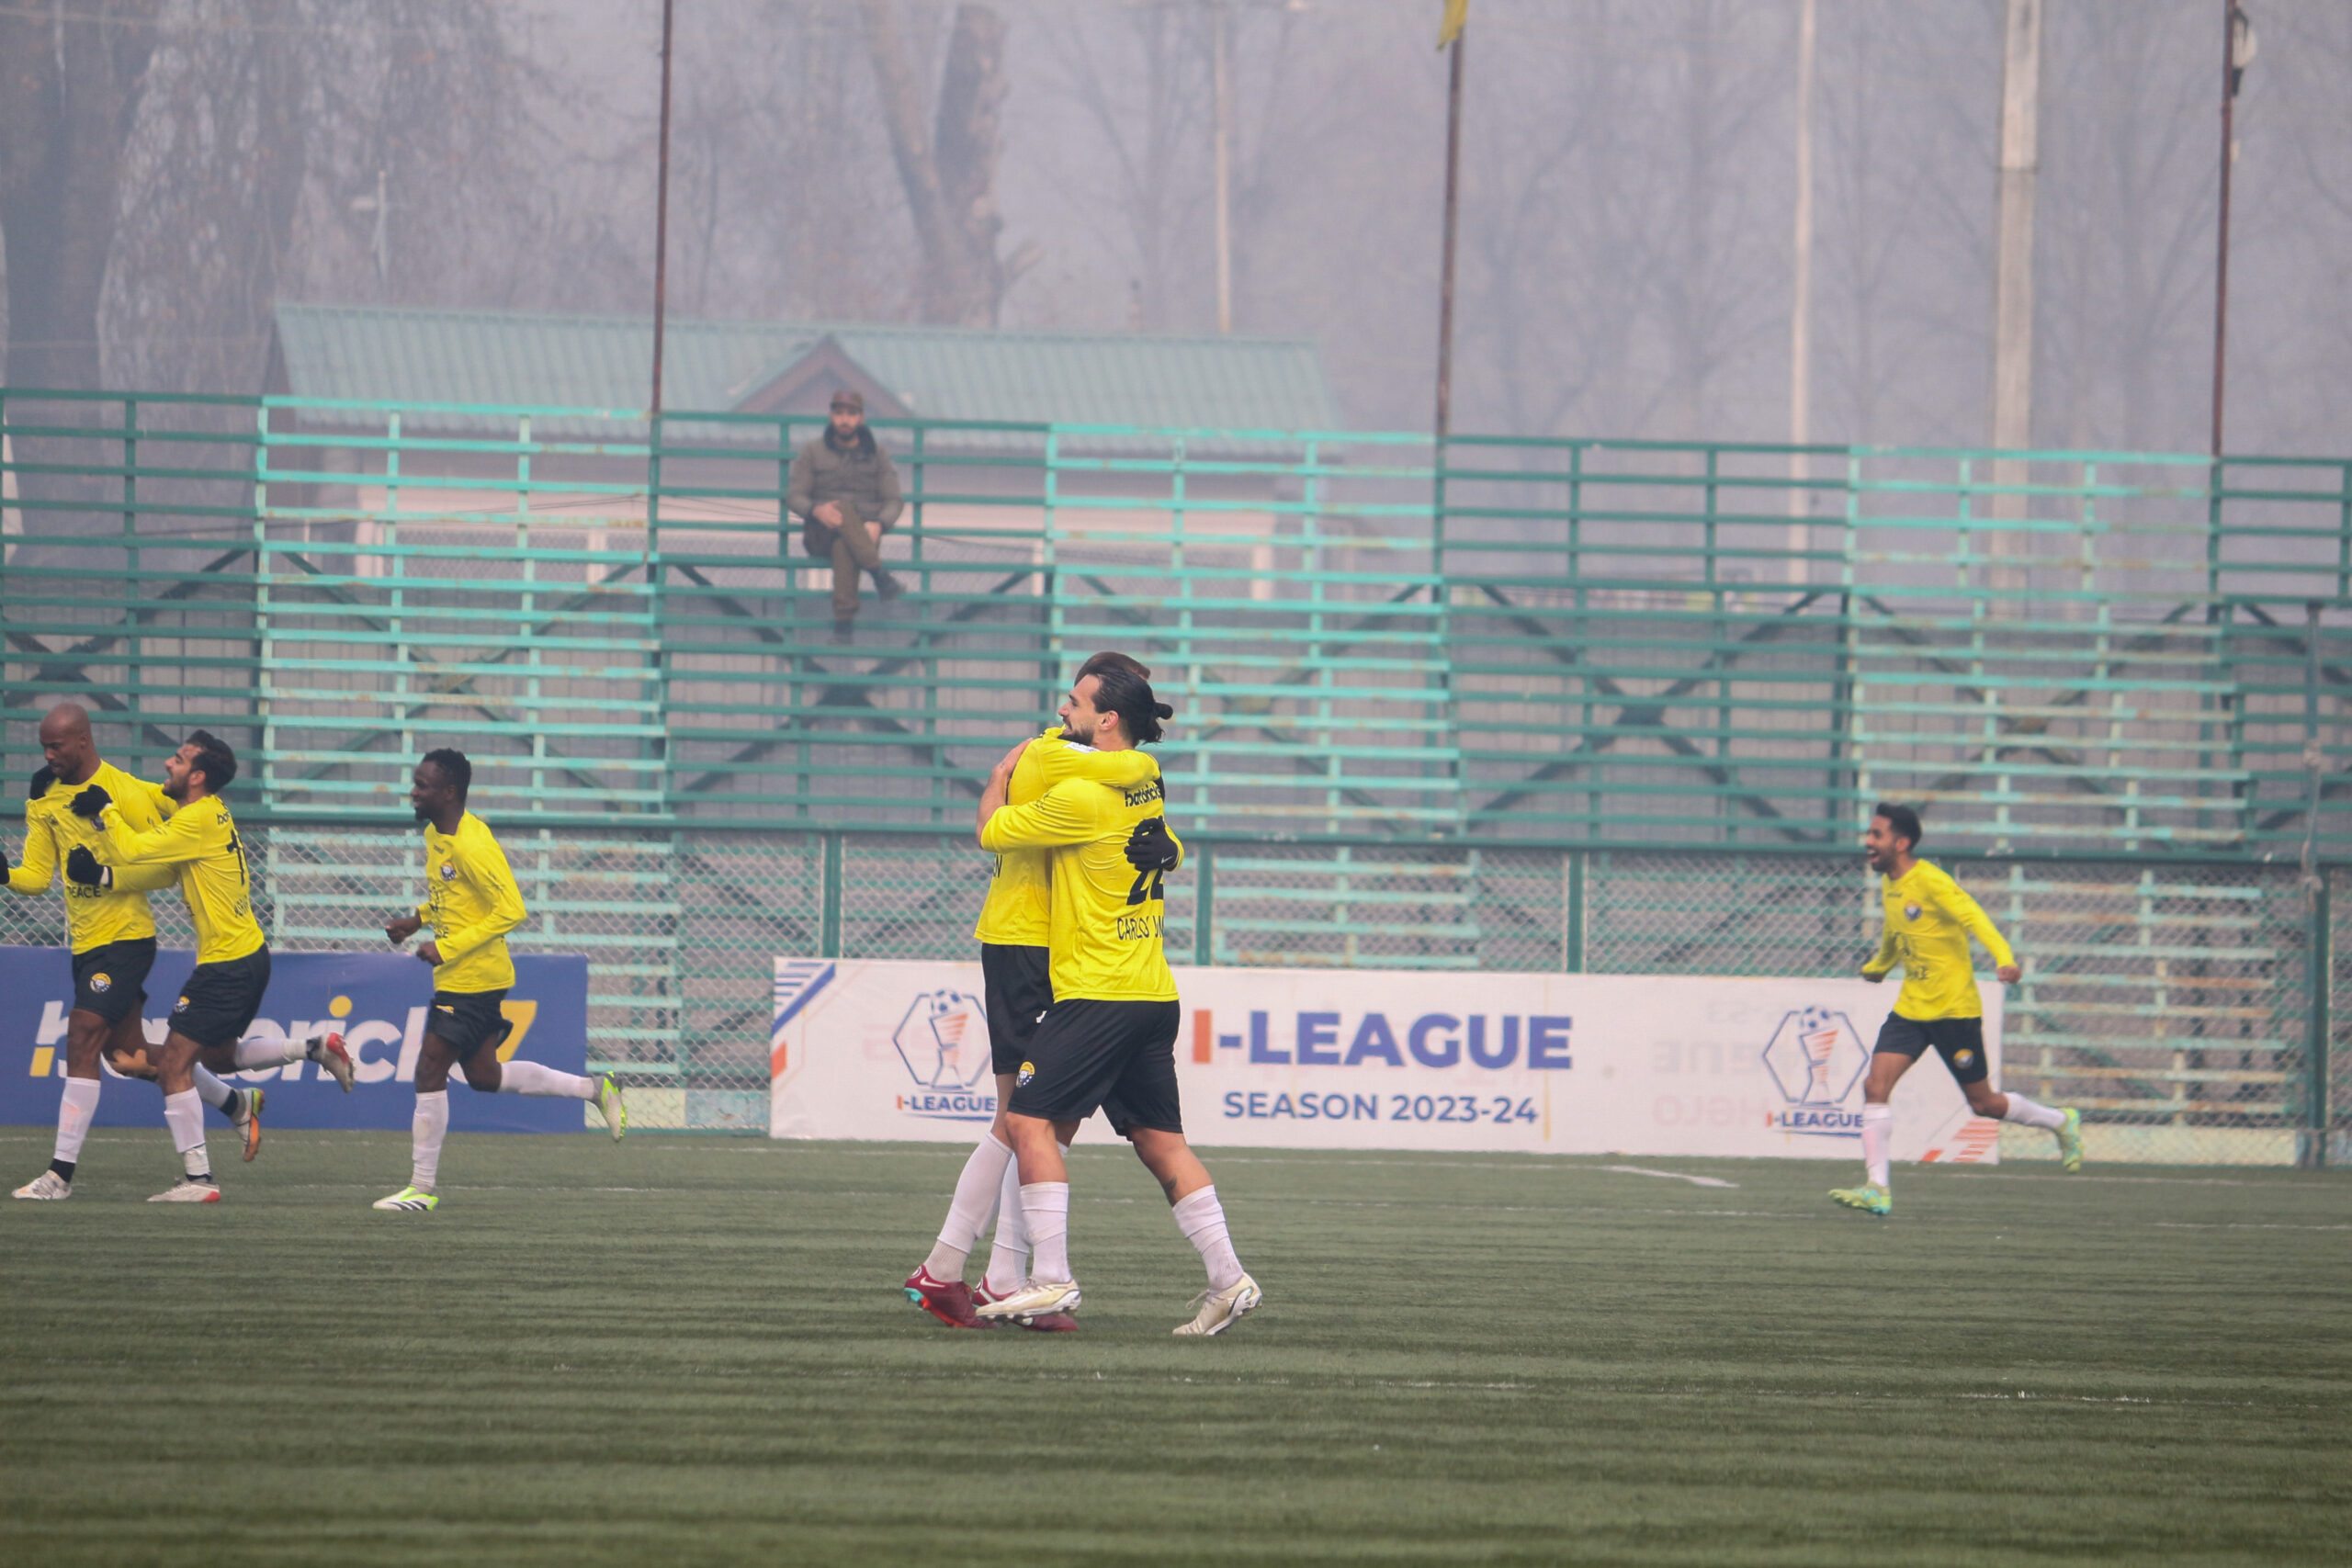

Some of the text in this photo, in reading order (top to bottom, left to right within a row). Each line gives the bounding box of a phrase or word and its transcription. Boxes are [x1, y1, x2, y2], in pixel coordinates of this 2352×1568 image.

[1192, 1009, 1573, 1070] I-LEAGUE
[897, 1095, 997, 1112] I-LEAGUE
[1223, 1090, 1538, 1124] SEASON 2023-24
[1767, 1111, 1863, 1129] I-LEAGUE
